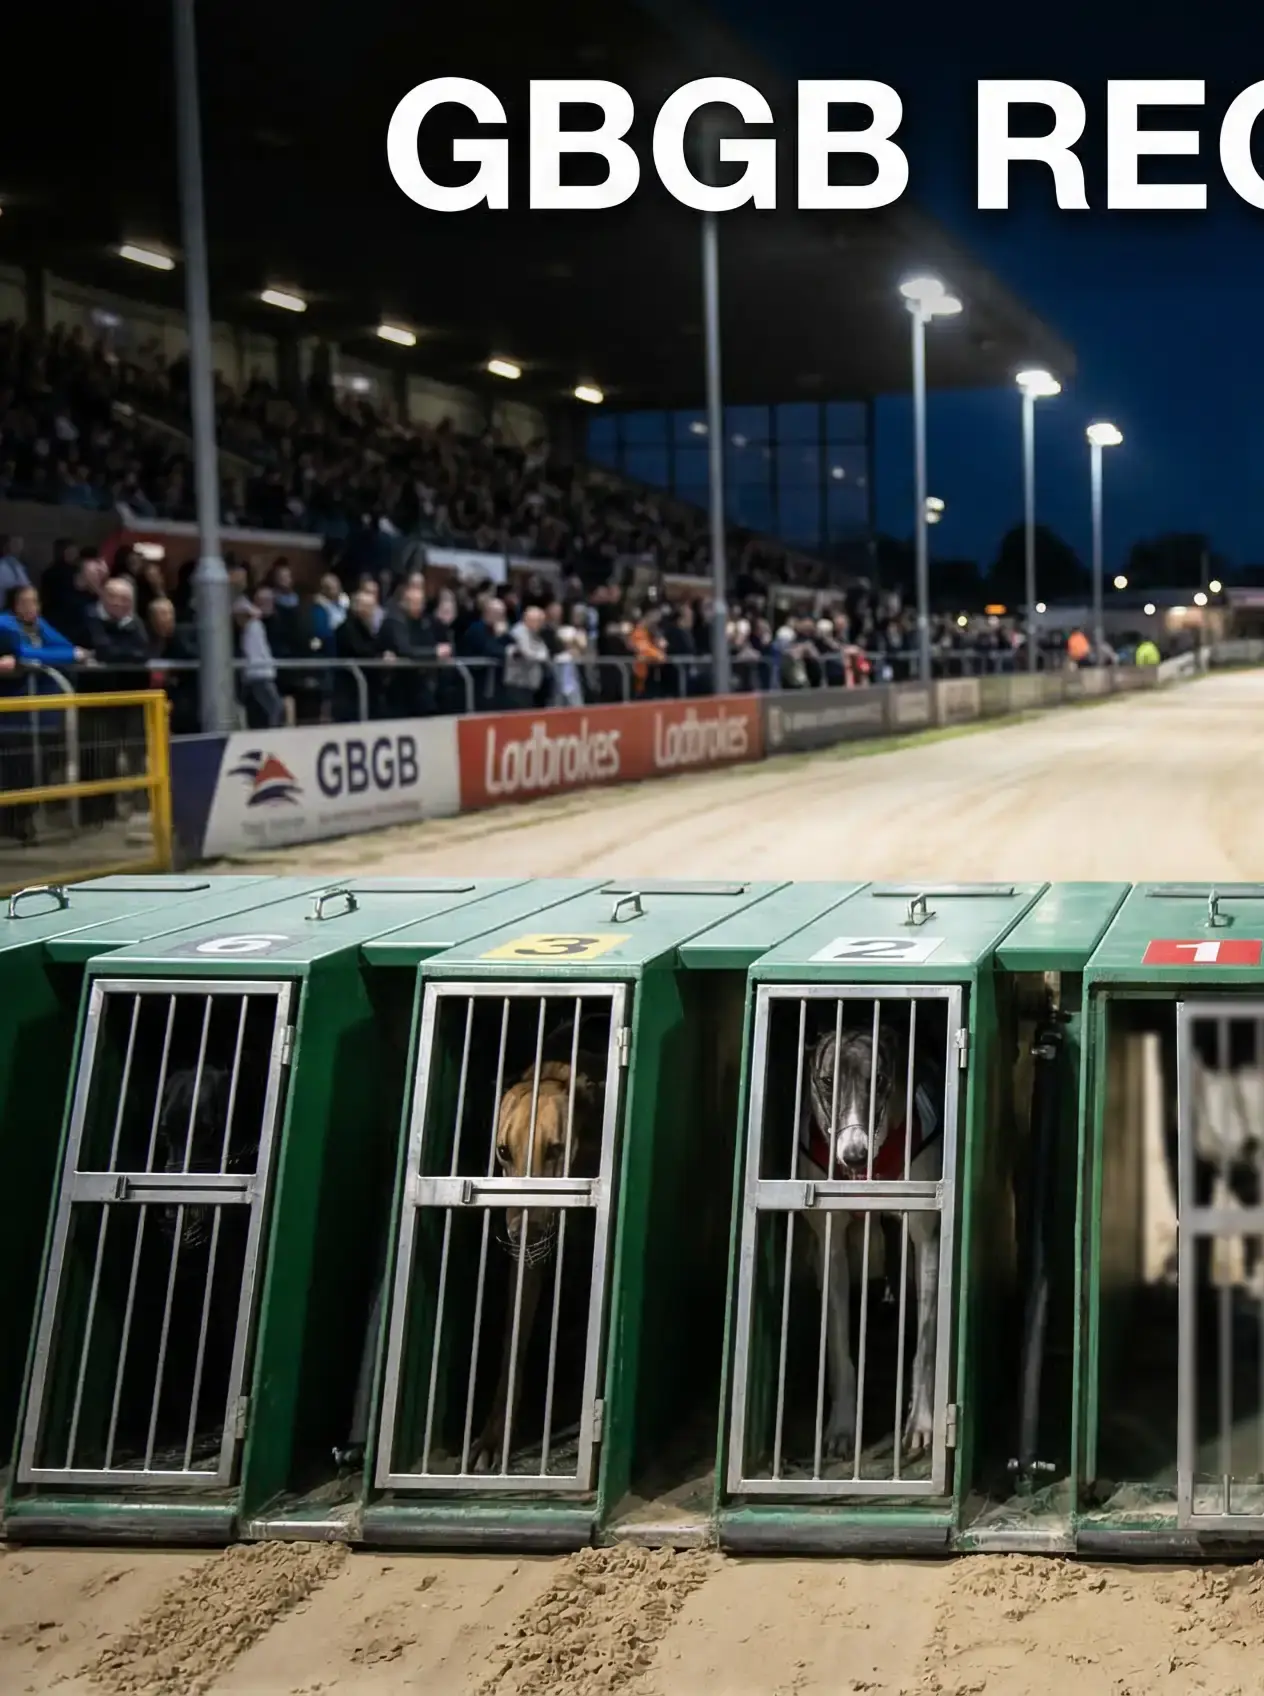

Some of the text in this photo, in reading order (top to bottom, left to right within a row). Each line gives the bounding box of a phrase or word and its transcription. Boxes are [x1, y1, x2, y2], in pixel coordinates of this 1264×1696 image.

[657, 704, 749, 768] Ladbrokes
[485, 715, 620, 794] Ladbrokes
[316, 735, 419, 798] GBGB
[196, 934, 288, 953] 6
[514, 937, 600, 955] 3
[833, 940, 917, 958] 2
[1176, 941, 1221, 962] 1
